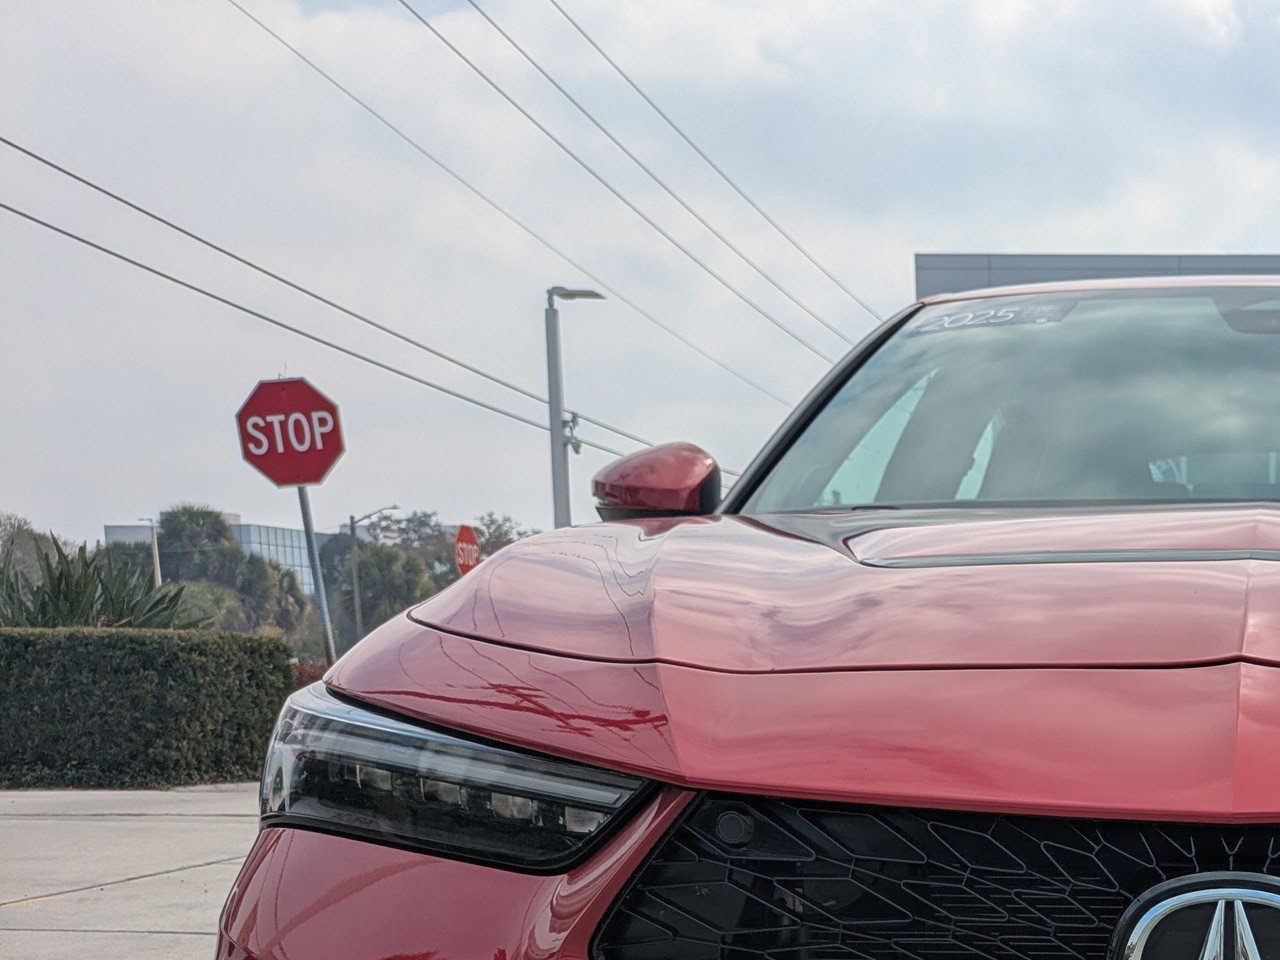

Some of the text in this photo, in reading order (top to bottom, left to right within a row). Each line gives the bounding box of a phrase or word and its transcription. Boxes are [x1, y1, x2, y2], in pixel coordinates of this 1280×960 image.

[919, 308, 1020, 332] 2025
[246, 410, 334, 456] STOP
[456, 542, 480, 565] STOP
